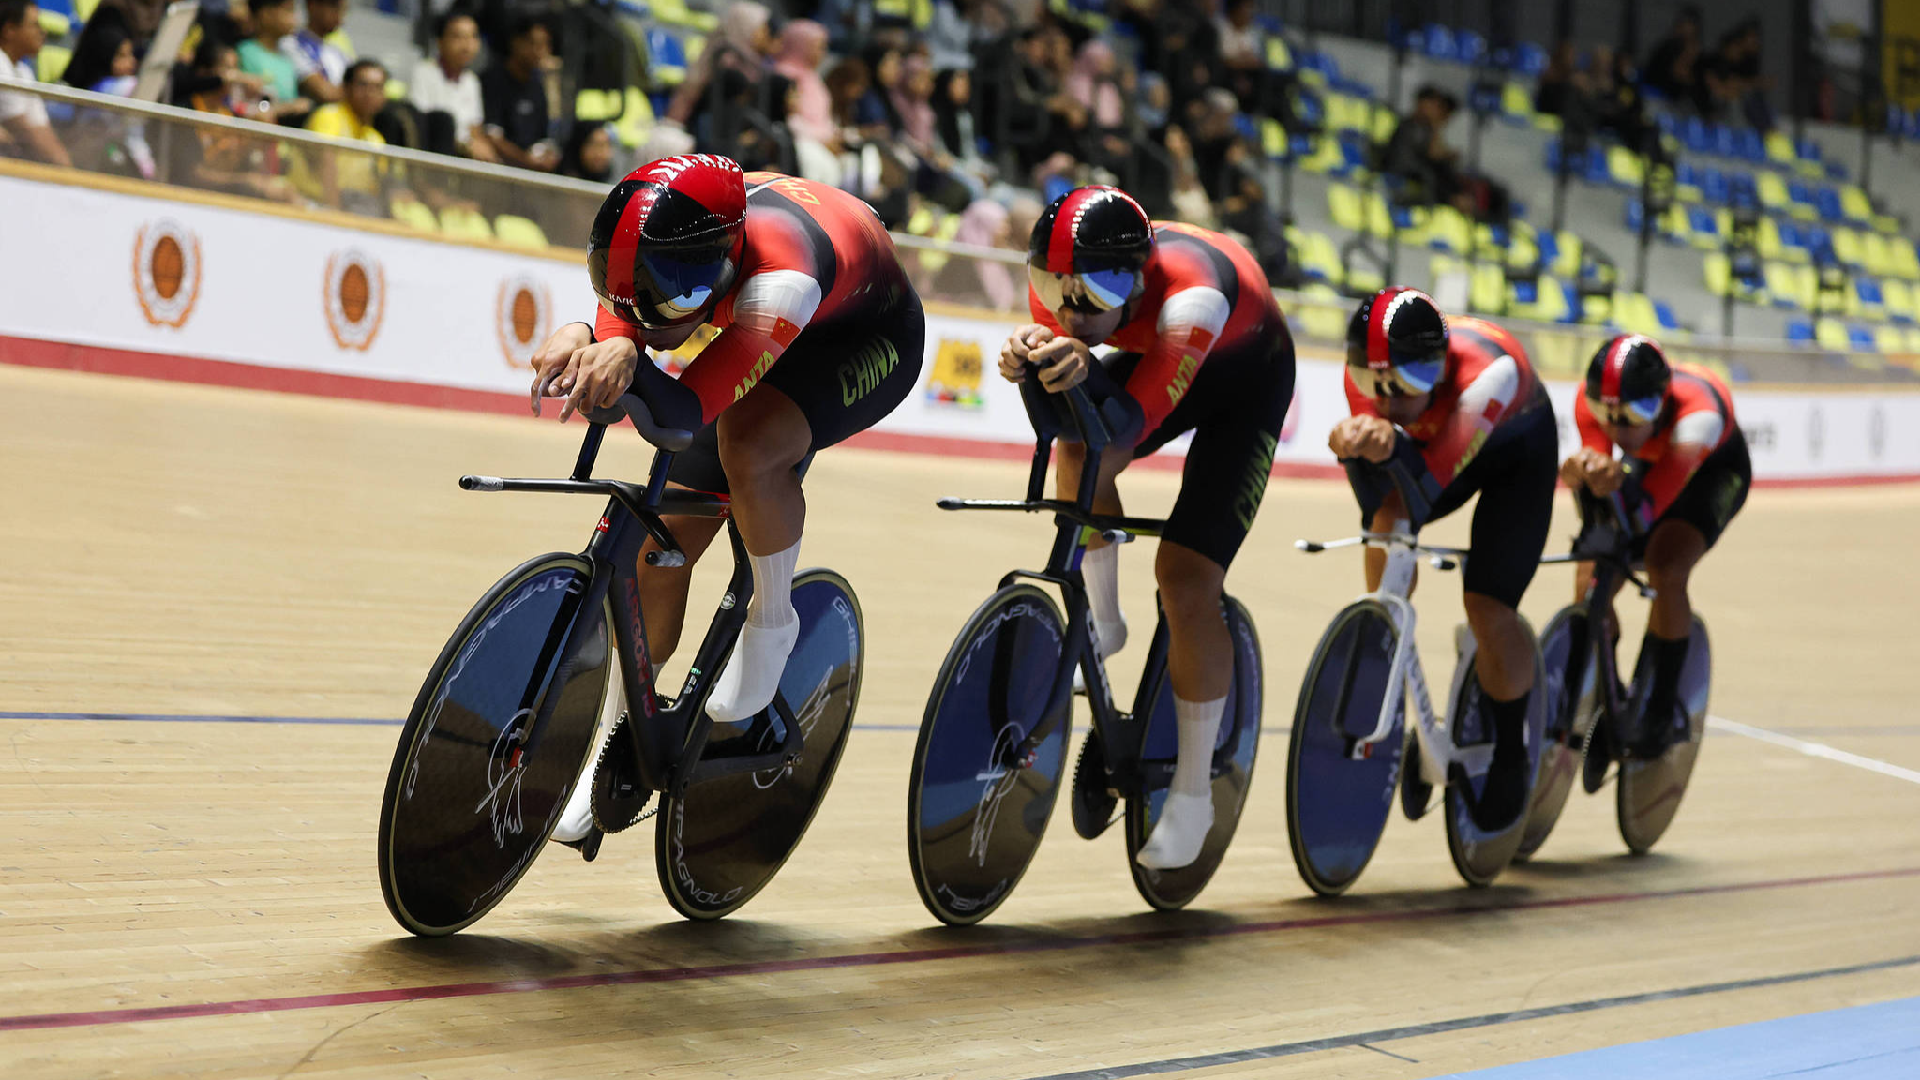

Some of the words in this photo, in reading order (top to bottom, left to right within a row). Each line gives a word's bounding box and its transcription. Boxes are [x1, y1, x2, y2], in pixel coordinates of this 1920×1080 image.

[733, 350, 775, 403] ANTA
[838, 334, 900, 408] CHINA
[1166, 354, 1198, 406] ANTA
